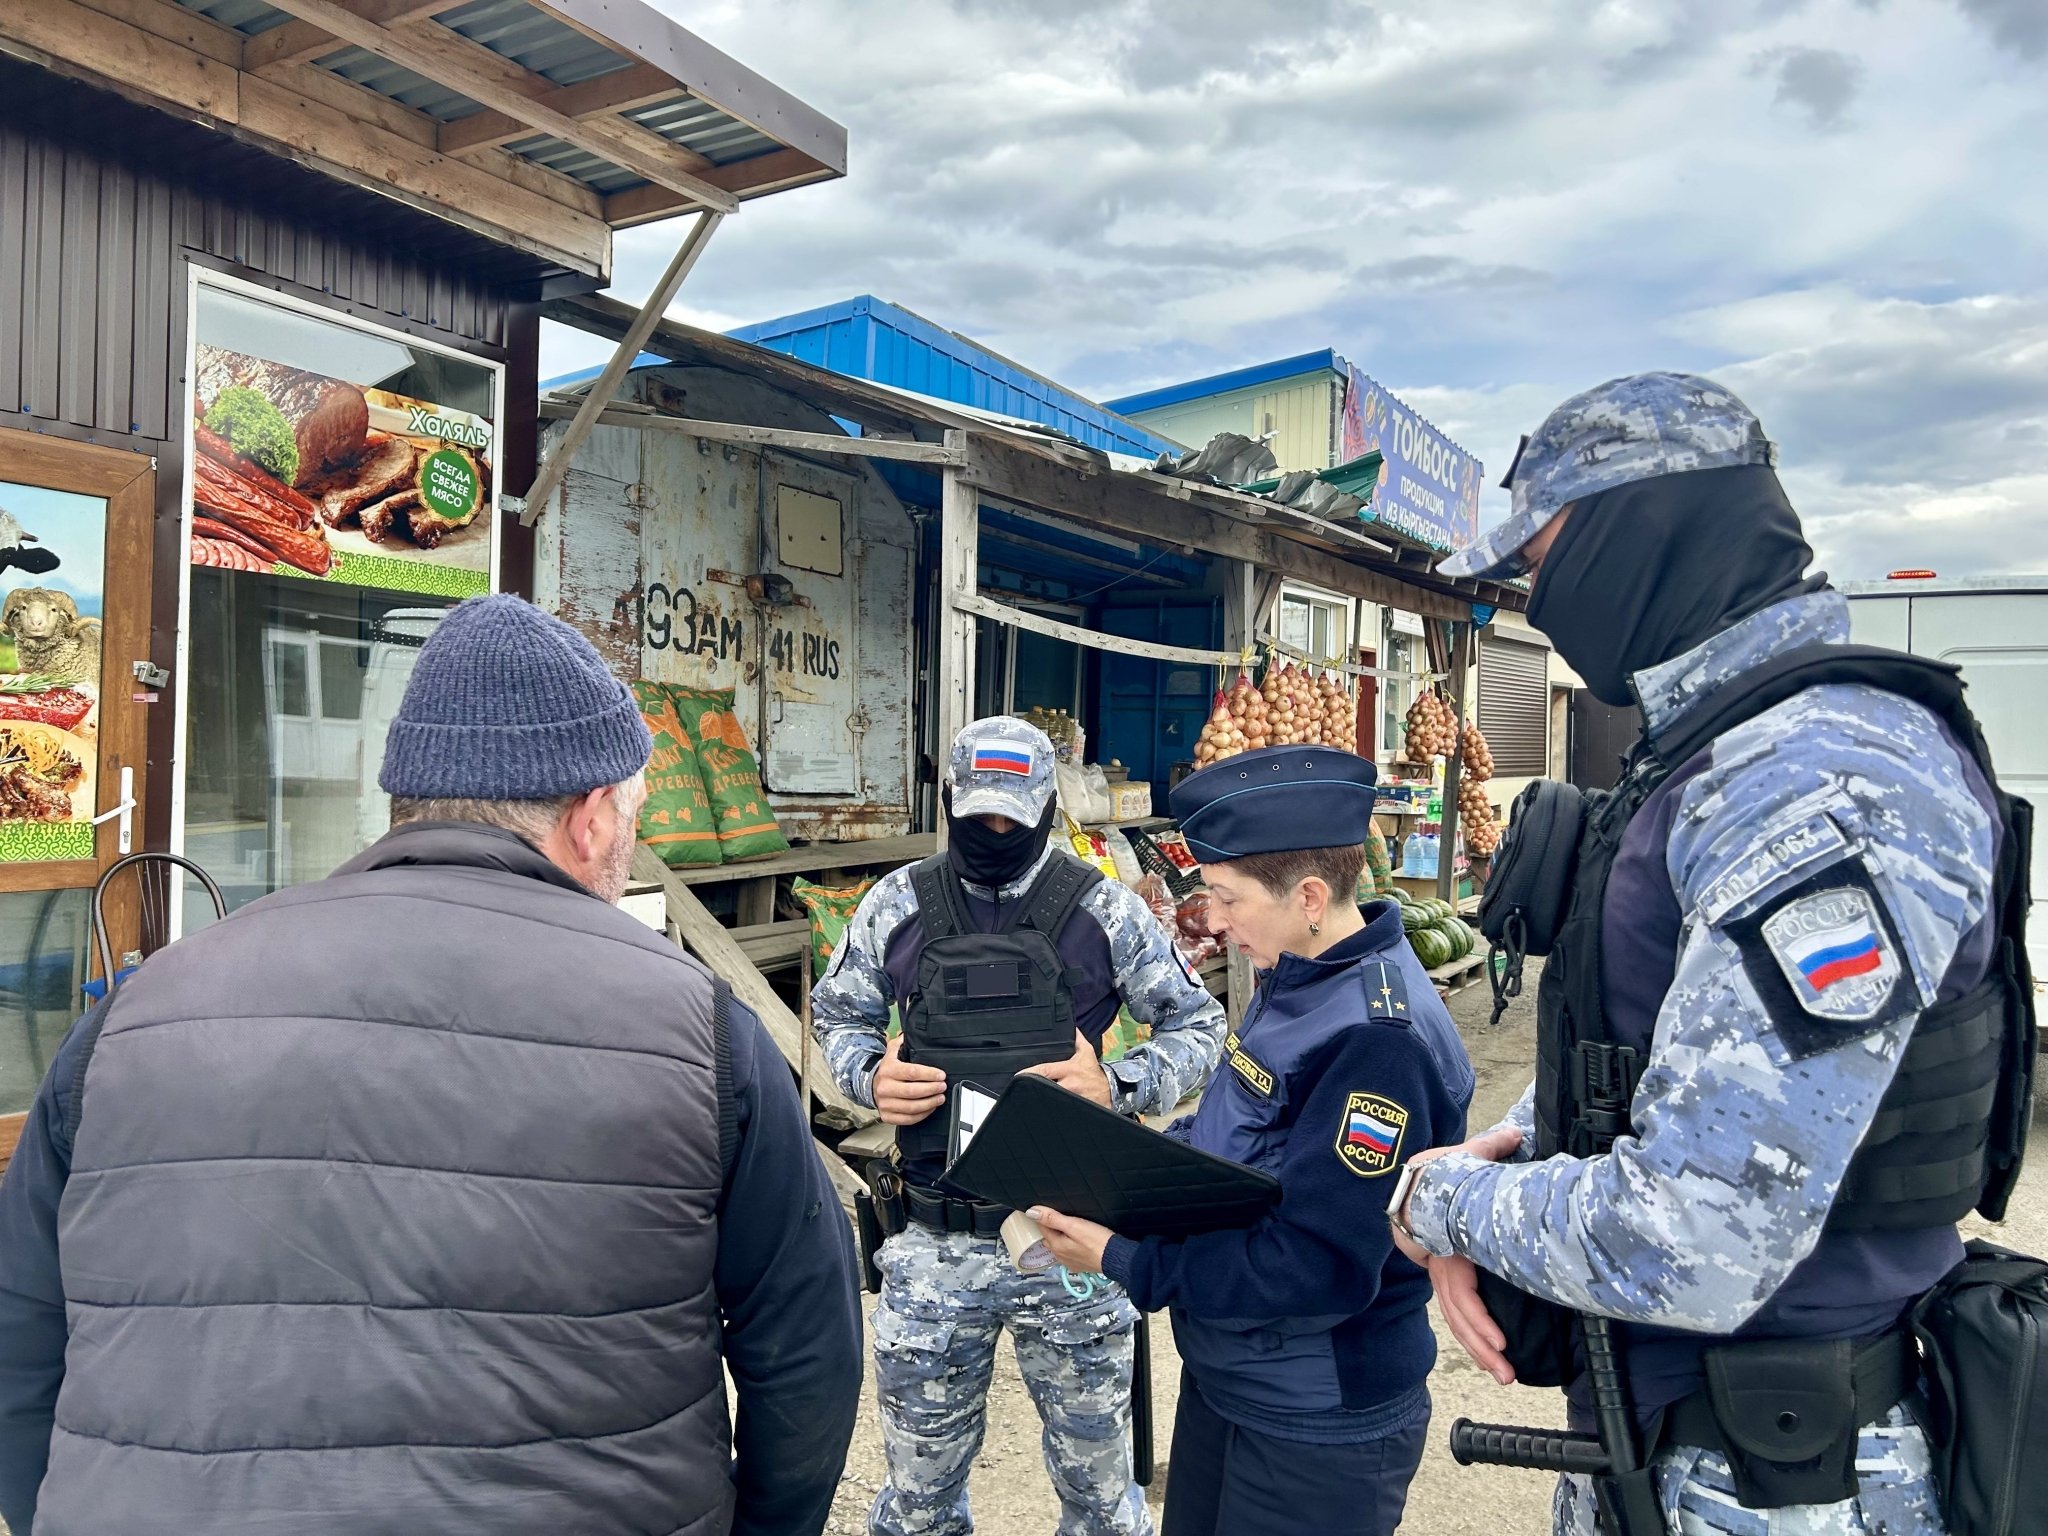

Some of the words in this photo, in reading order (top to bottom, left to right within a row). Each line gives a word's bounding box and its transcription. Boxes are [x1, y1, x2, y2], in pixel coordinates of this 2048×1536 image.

[408, 405, 488, 447] Халяль
[433, 458, 471, 484] ВСЕГДА
[1392, 409, 1458, 492] ТОЙБОСС
[431, 472, 469, 497] СВЕЖЕЕ
[432, 486, 462, 508] МЯСО
[1401, 475, 1444, 518] ПРОДУКЦИЯ
[1386, 499, 1398, 522] ИЗ
[1399, 506, 1451, 550] КЫРГЫЗСТАНА
[769, 627, 793, 673] 41
[802, 632, 840, 680] RUS
[1751, 826, 1819, 876] 21063
[1768, 900, 1867, 944] РОССИЯ
[1830, 975, 1892, 1009] ФССП
[1350, 1098, 1406, 1124] РОССИЯ
[1343, 1143, 1386, 1169] ФССП
